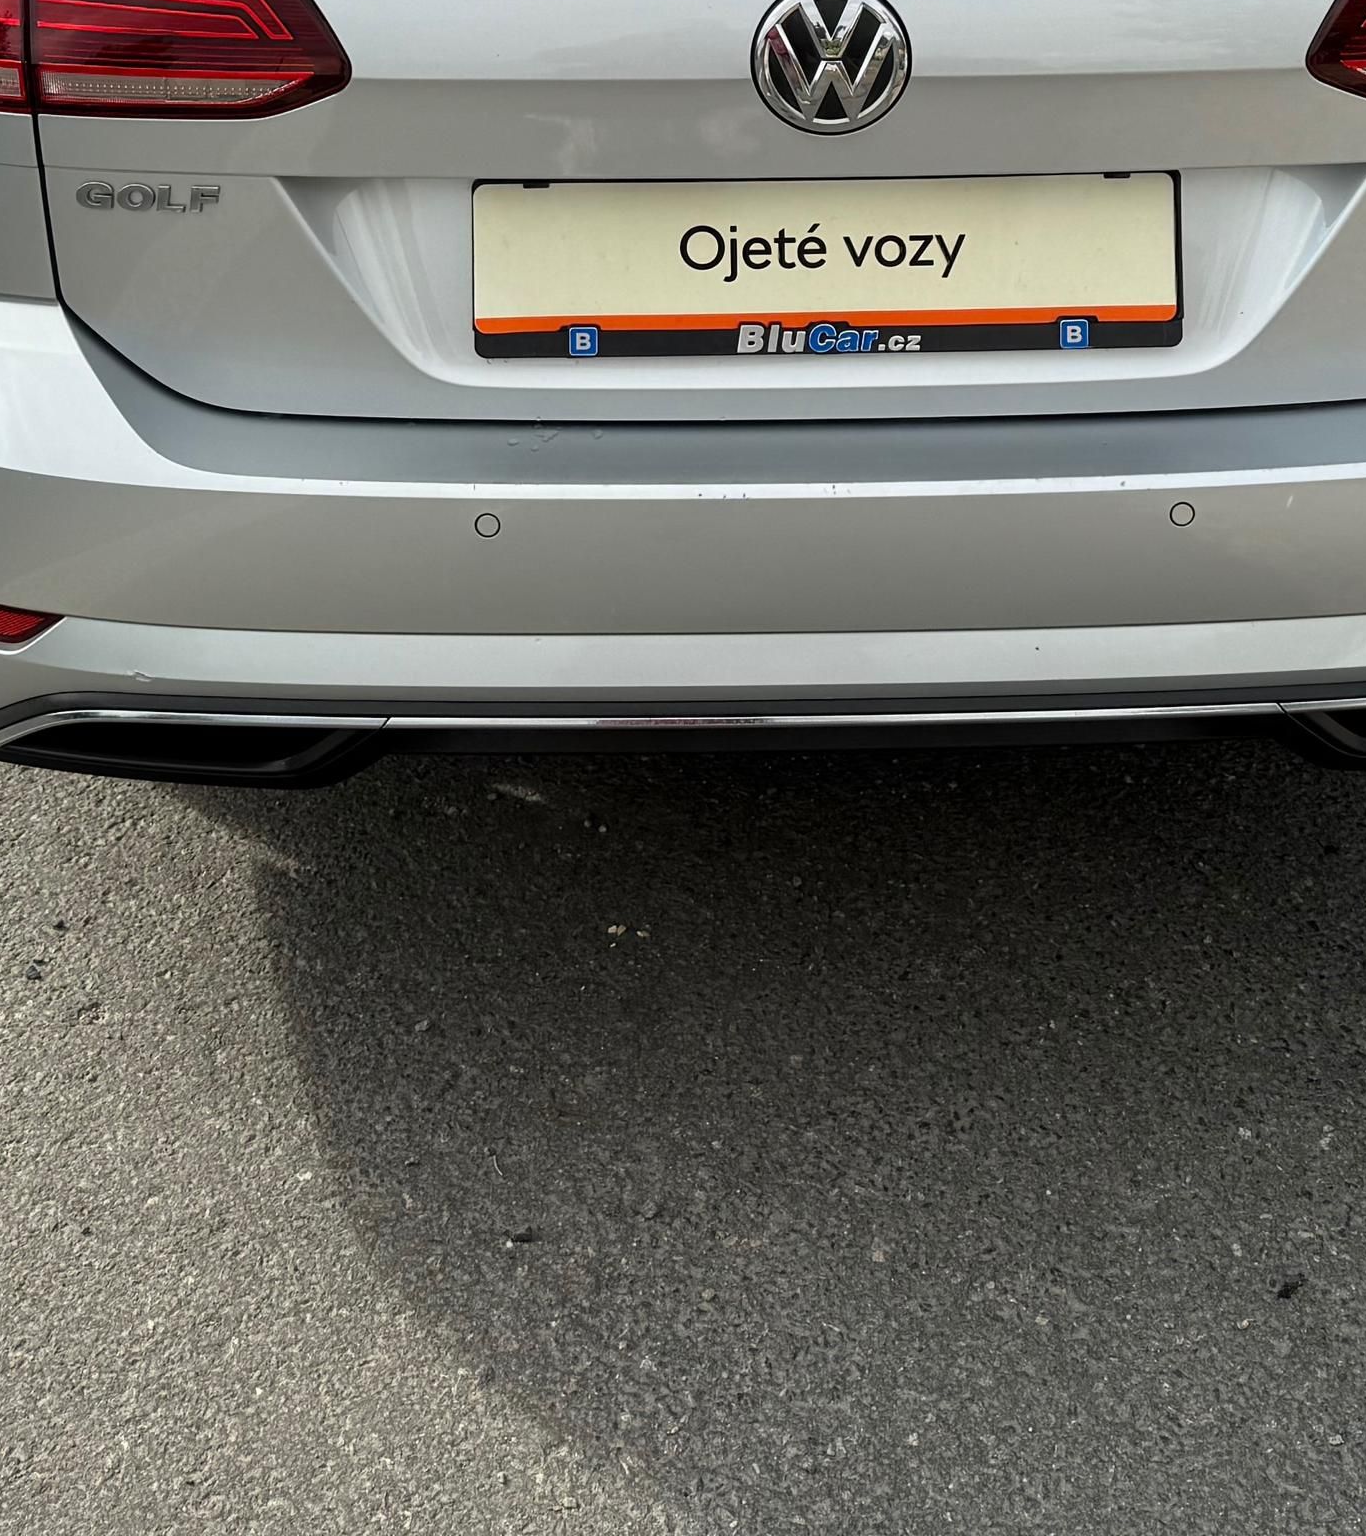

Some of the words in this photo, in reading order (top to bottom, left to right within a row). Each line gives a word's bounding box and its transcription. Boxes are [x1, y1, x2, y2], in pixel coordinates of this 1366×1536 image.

[76, 181, 221, 213] GOLF
[679, 223, 827, 283] Ojeté
[842, 233, 966, 278] vozy
[737, 323, 922, 354] BluCar.cz
